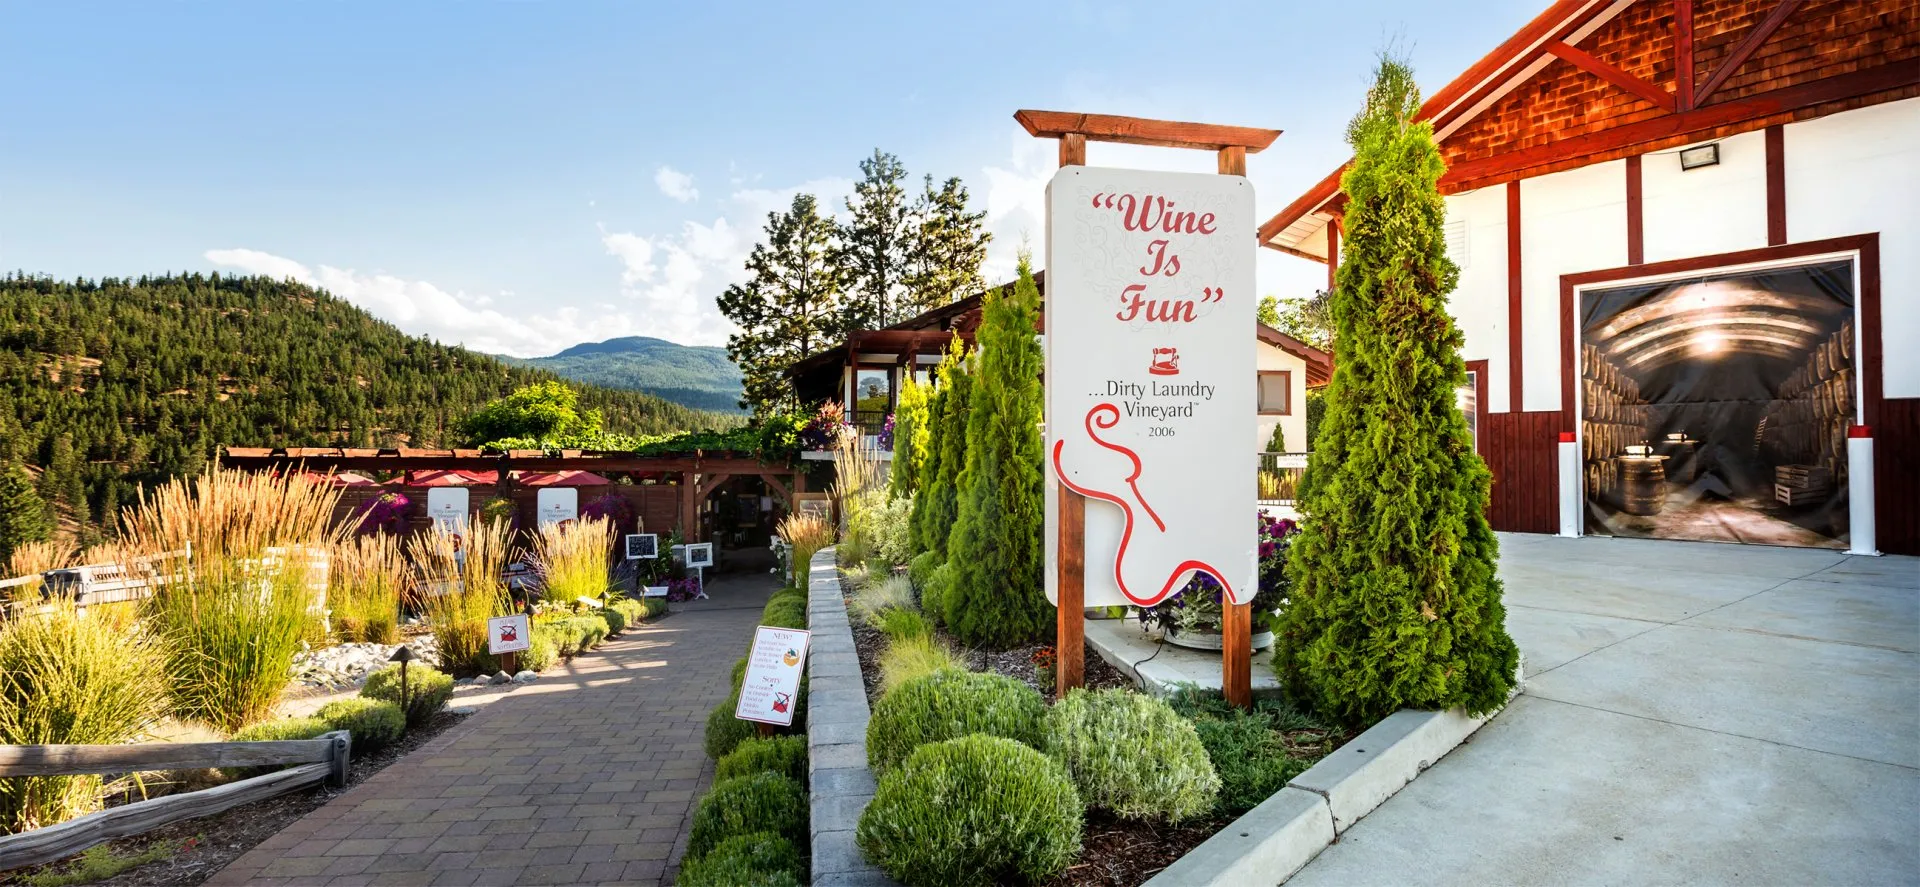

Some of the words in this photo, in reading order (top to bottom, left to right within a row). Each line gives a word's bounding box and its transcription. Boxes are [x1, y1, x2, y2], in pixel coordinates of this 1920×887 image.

[1139, 239, 1181, 277] Is
[1152, 381, 1215, 400] Laundry
[1148, 427, 1175, 437] 2006
